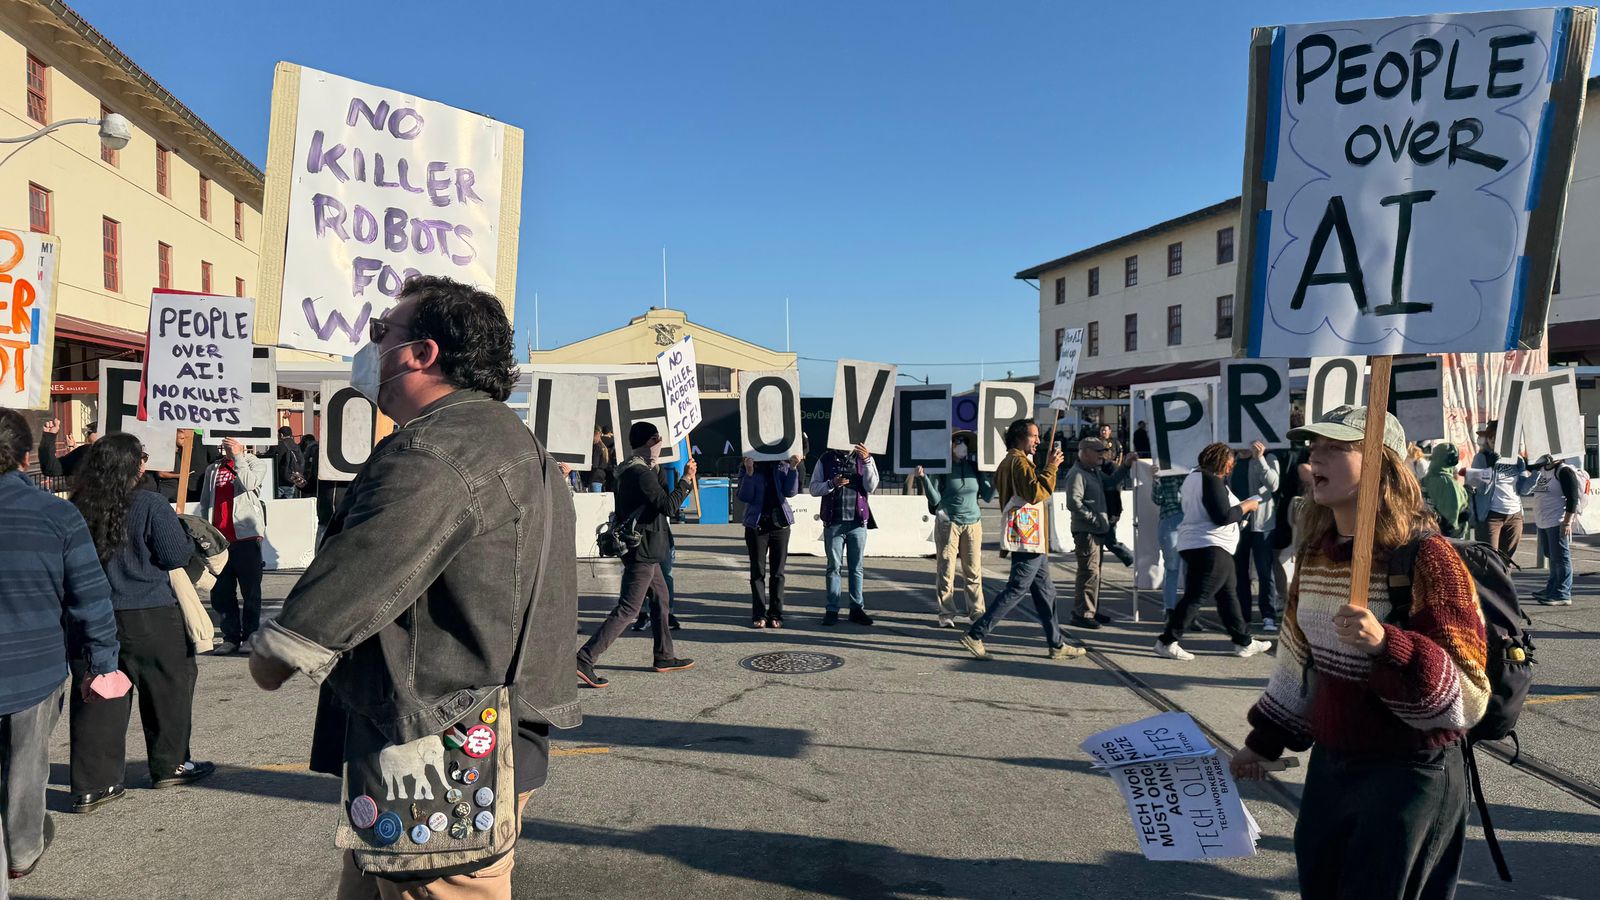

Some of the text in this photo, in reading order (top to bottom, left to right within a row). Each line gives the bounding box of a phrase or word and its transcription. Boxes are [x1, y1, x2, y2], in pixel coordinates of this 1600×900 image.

[1296, 30, 1538, 106] PEOPLE
[346, 97, 425, 140] NO
[307, 129, 484, 207] KILLER
[312, 192, 477, 266] ROBOTS
[1290, 189, 1440, 317] AI
[159, 307, 248, 339] PEOPLE
[302, 296, 388, 345] W
[172, 343, 224, 359] OVER
[668, 351, 683, 370] NO
[176, 361, 224, 380] AI!
[665, 365, 693, 396] KILLER
[153, 384, 244, 404] NO KILLER
[670, 376, 695, 406] ROBOTS
[678, 397, 692, 414] FOR
[159, 400, 241, 425] ROBOTS
[673, 404, 699, 438] ICE!
[800, 409, 832, 420] DevDa
[1101, 741, 1125, 762] ERS
[1114, 735, 1141, 761] NIZE
[1140, 764, 1160, 798] ORG
[1153, 762, 1183, 816] AGAINS
[1206, 766, 1222, 807] WORKERS
[1219, 778, 1229, 794] BAY
[1124, 767, 1158, 845] TECH WOR
[1216, 807, 1229, 831] TECH
[1151, 802, 1175, 847] MUST
[1189, 809, 1223, 855] TECH
